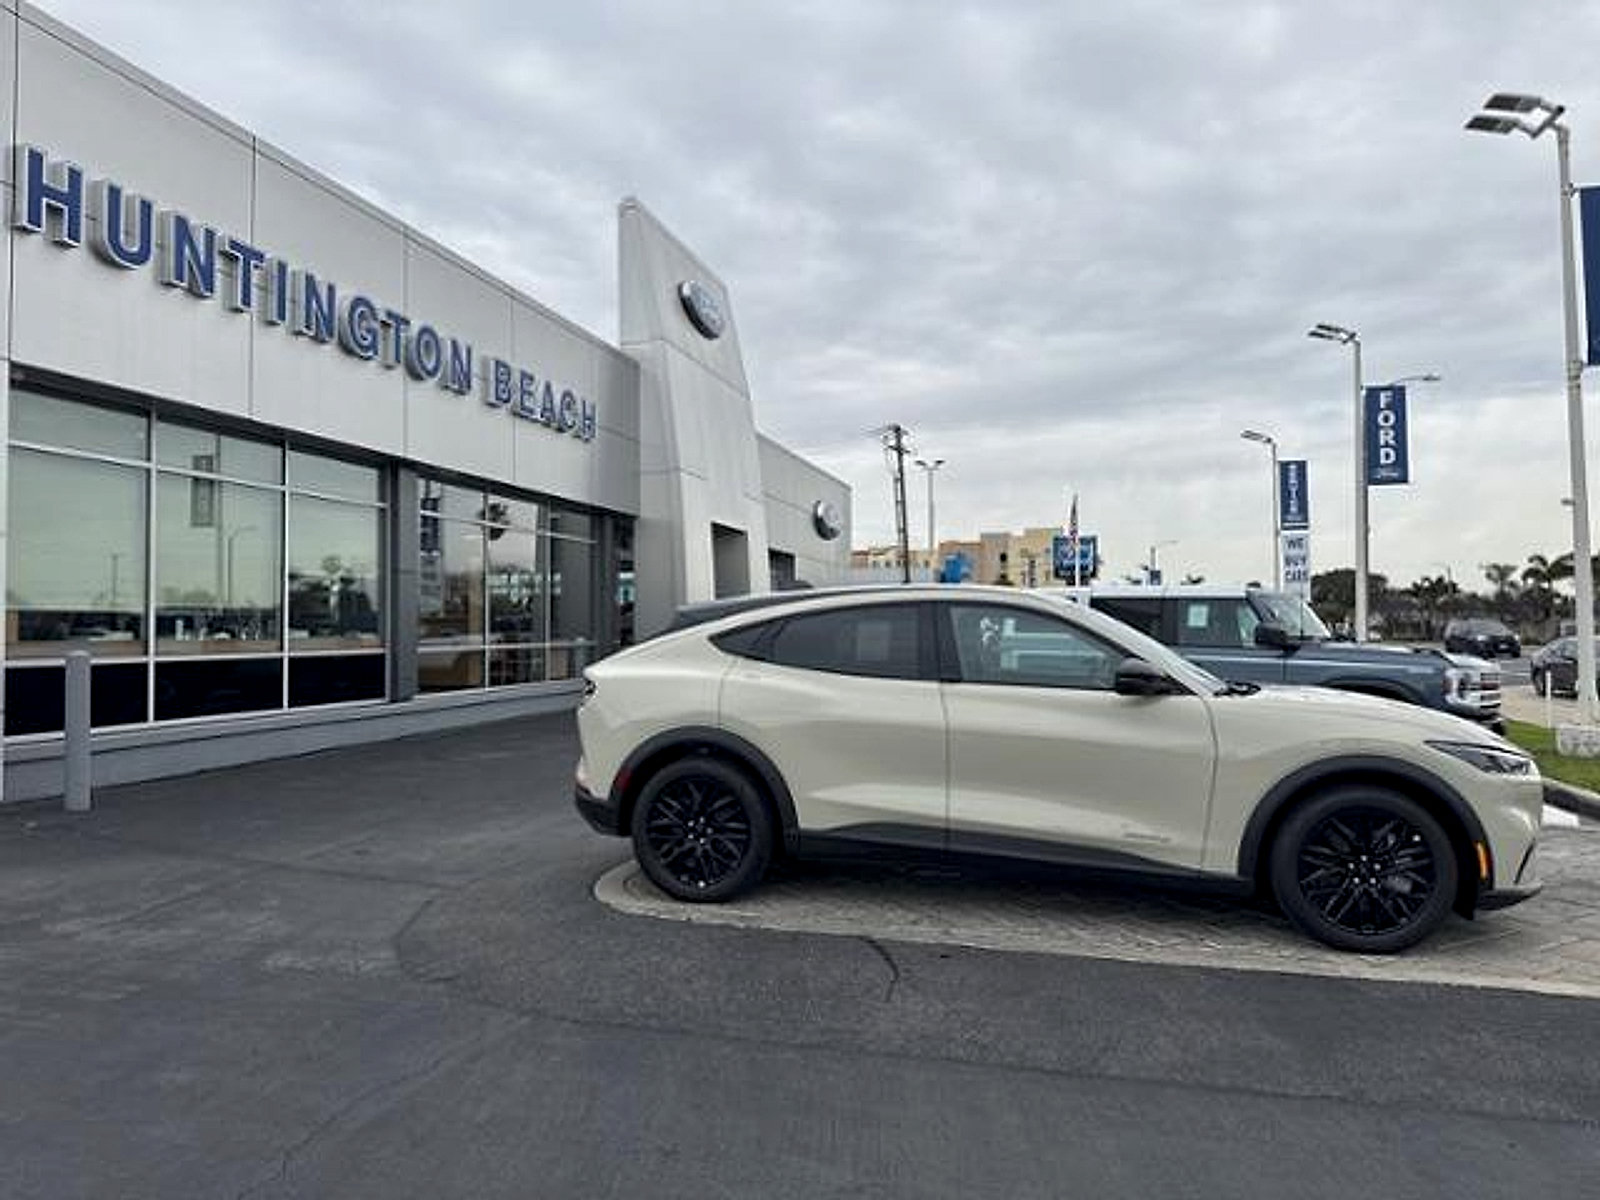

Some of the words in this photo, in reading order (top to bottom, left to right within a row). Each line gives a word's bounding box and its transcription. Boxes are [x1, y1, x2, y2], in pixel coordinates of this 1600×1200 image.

[22, 146, 473, 394] HUNTINGTON
[492, 358, 597, 442] BEACH
[1378, 390, 1397, 464] FORD
